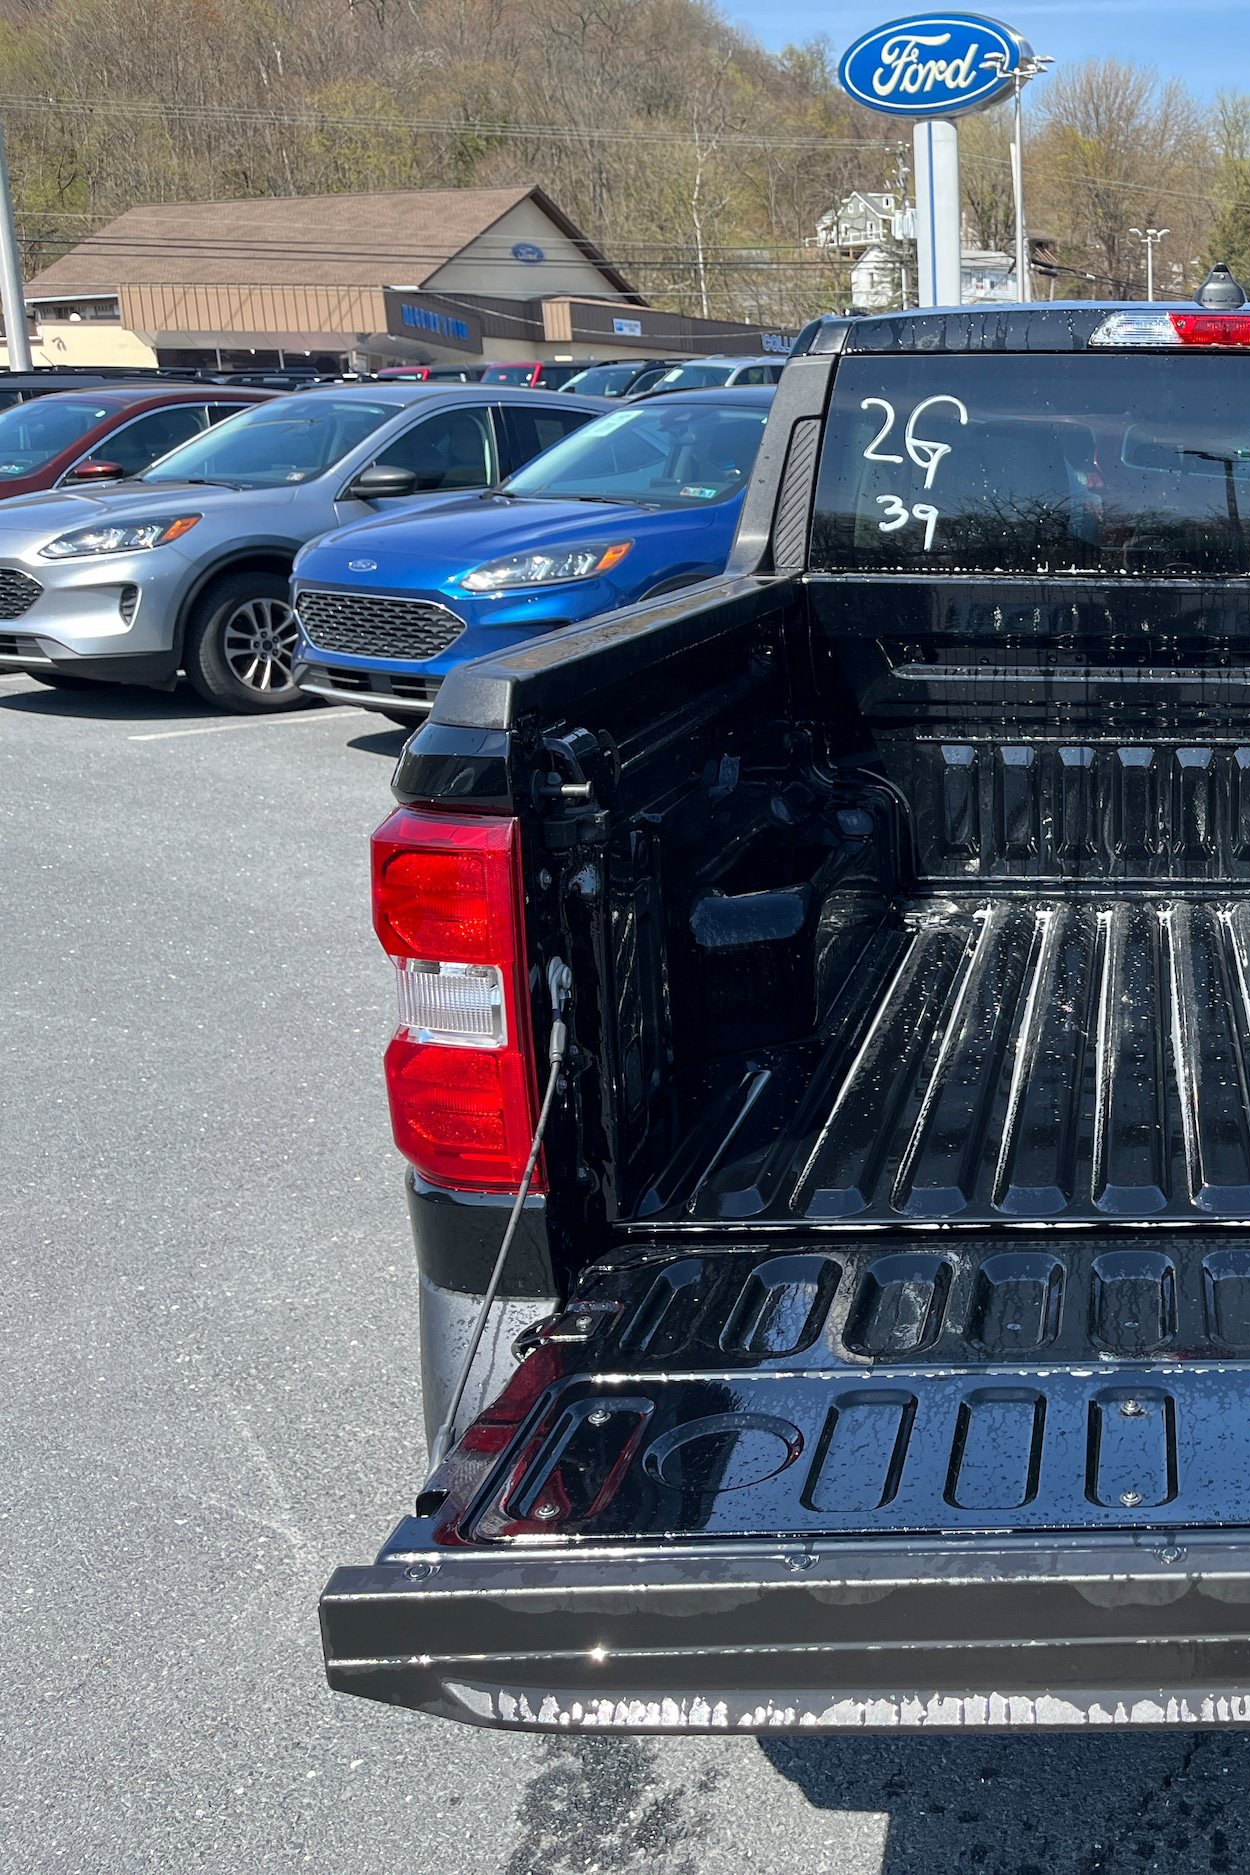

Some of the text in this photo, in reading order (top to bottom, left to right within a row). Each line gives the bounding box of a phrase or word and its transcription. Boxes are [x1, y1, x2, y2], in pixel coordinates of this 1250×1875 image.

[872, 33, 979, 96] Ford
[762, 333, 798, 353] COLLI
[875, 494, 939, 552] 39
